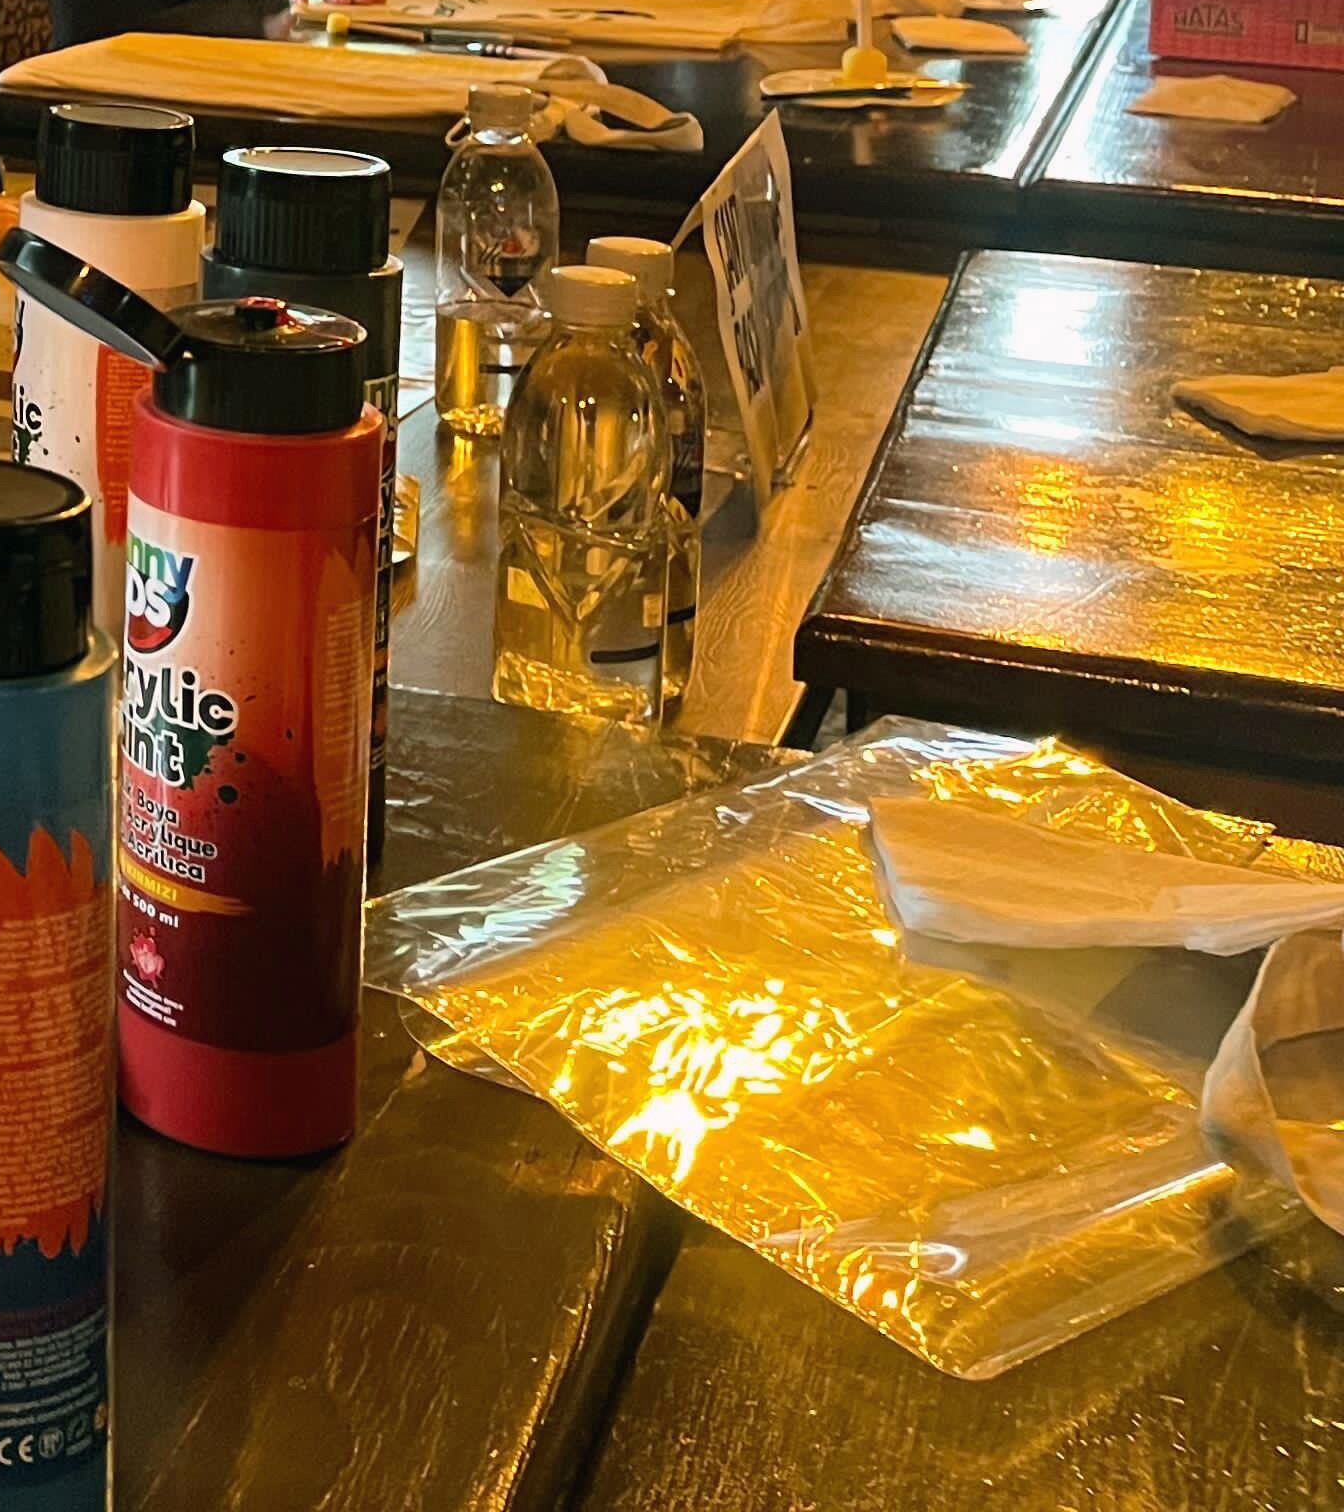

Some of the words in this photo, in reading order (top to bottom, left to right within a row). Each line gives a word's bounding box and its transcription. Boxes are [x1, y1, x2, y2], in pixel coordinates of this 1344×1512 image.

[137, 789, 177, 824] Boya
[133, 894, 156, 917] 500
[159, 912, 179, 928] ml
